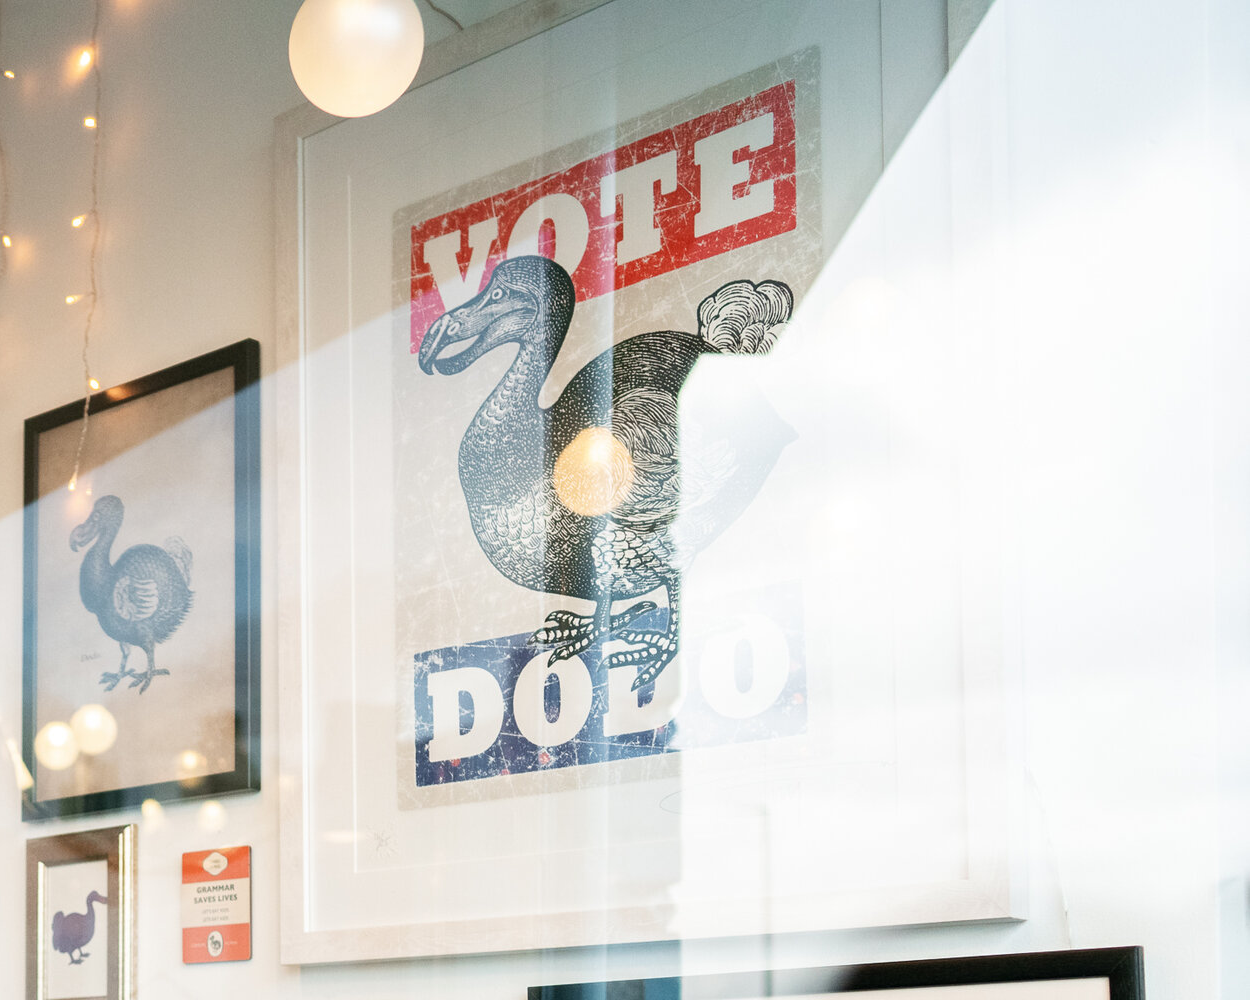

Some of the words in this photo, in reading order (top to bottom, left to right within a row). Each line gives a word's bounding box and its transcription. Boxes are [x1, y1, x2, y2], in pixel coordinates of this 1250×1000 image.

[423, 112, 778, 312] VOTE
[197, 884, 235, 893] GRAMMAR
[194, 895, 216, 904] SAVES
[218, 894, 238, 902] LIVES
